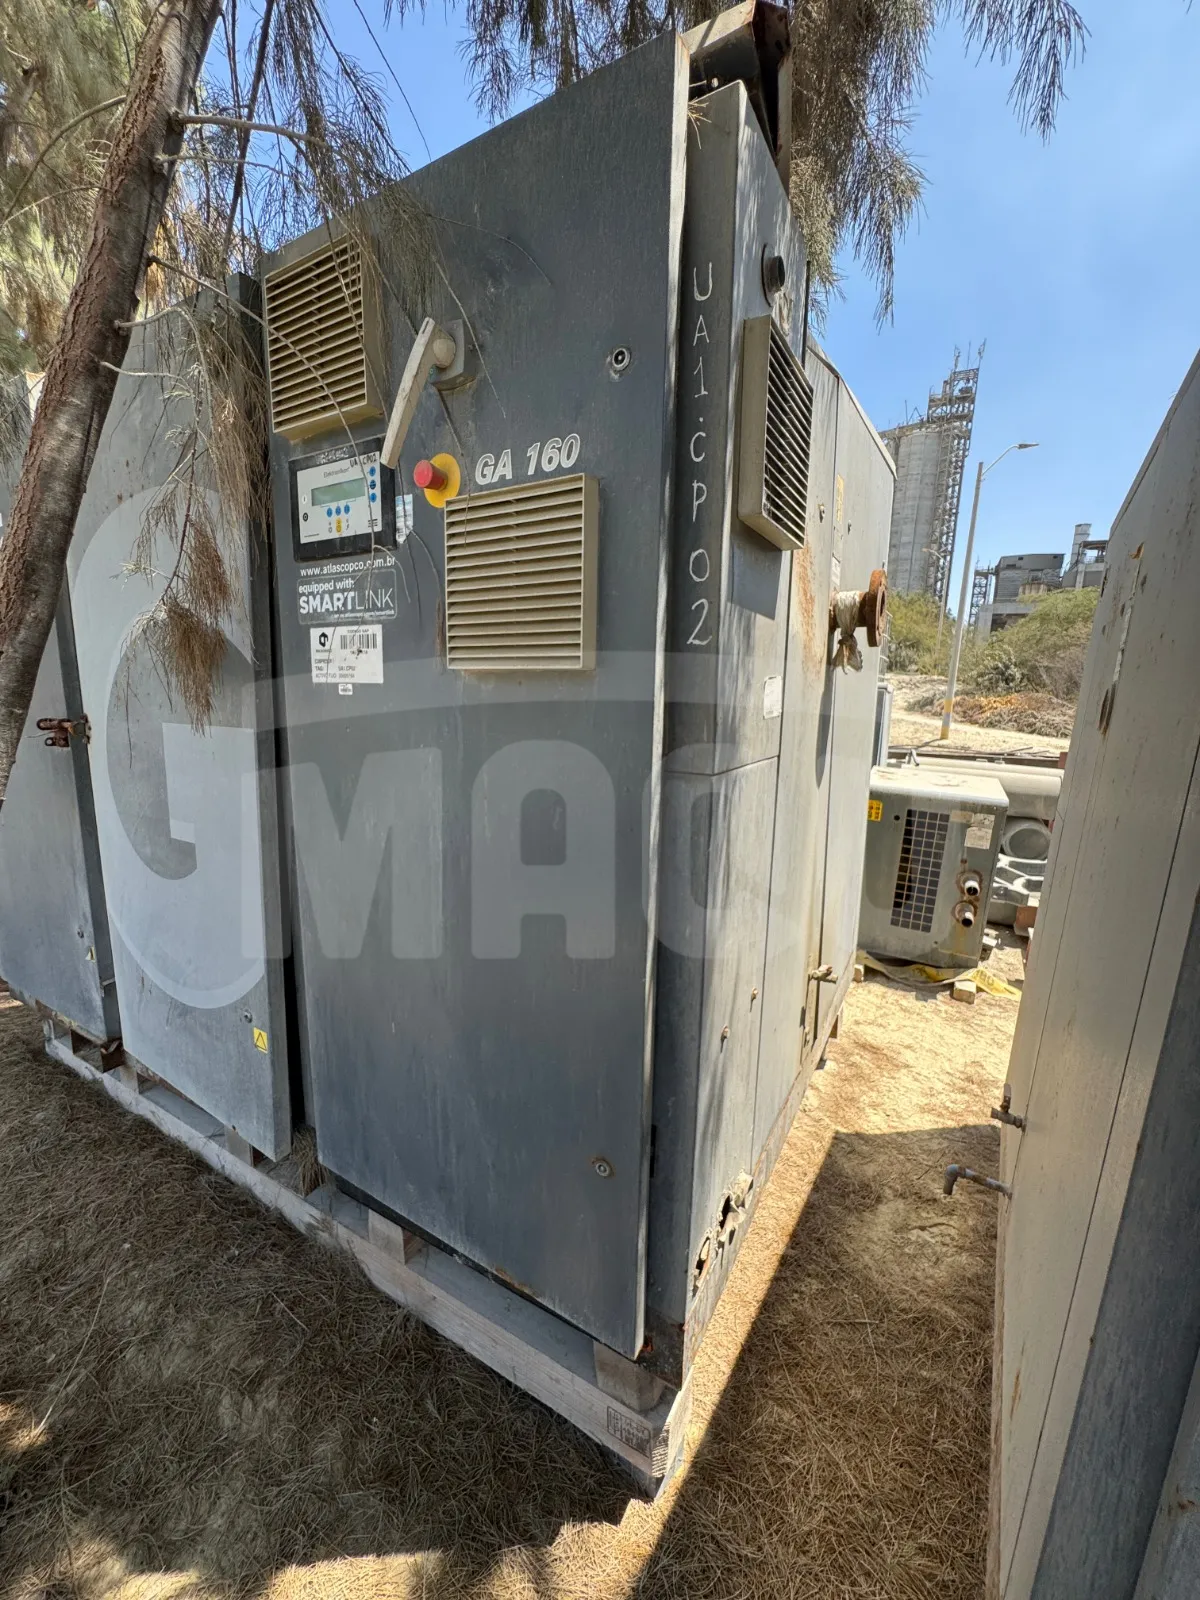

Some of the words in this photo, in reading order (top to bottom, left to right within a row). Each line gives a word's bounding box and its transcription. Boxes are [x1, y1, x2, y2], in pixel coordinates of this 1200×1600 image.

[475, 448, 513, 486] GA
[526, 433, 580, 476] 160
[300, 556, 396, 577] www.atlascopco.com.br
[299, 580, 334, 594] equipped
[300, 588, 394, 614] SMARTLINK
